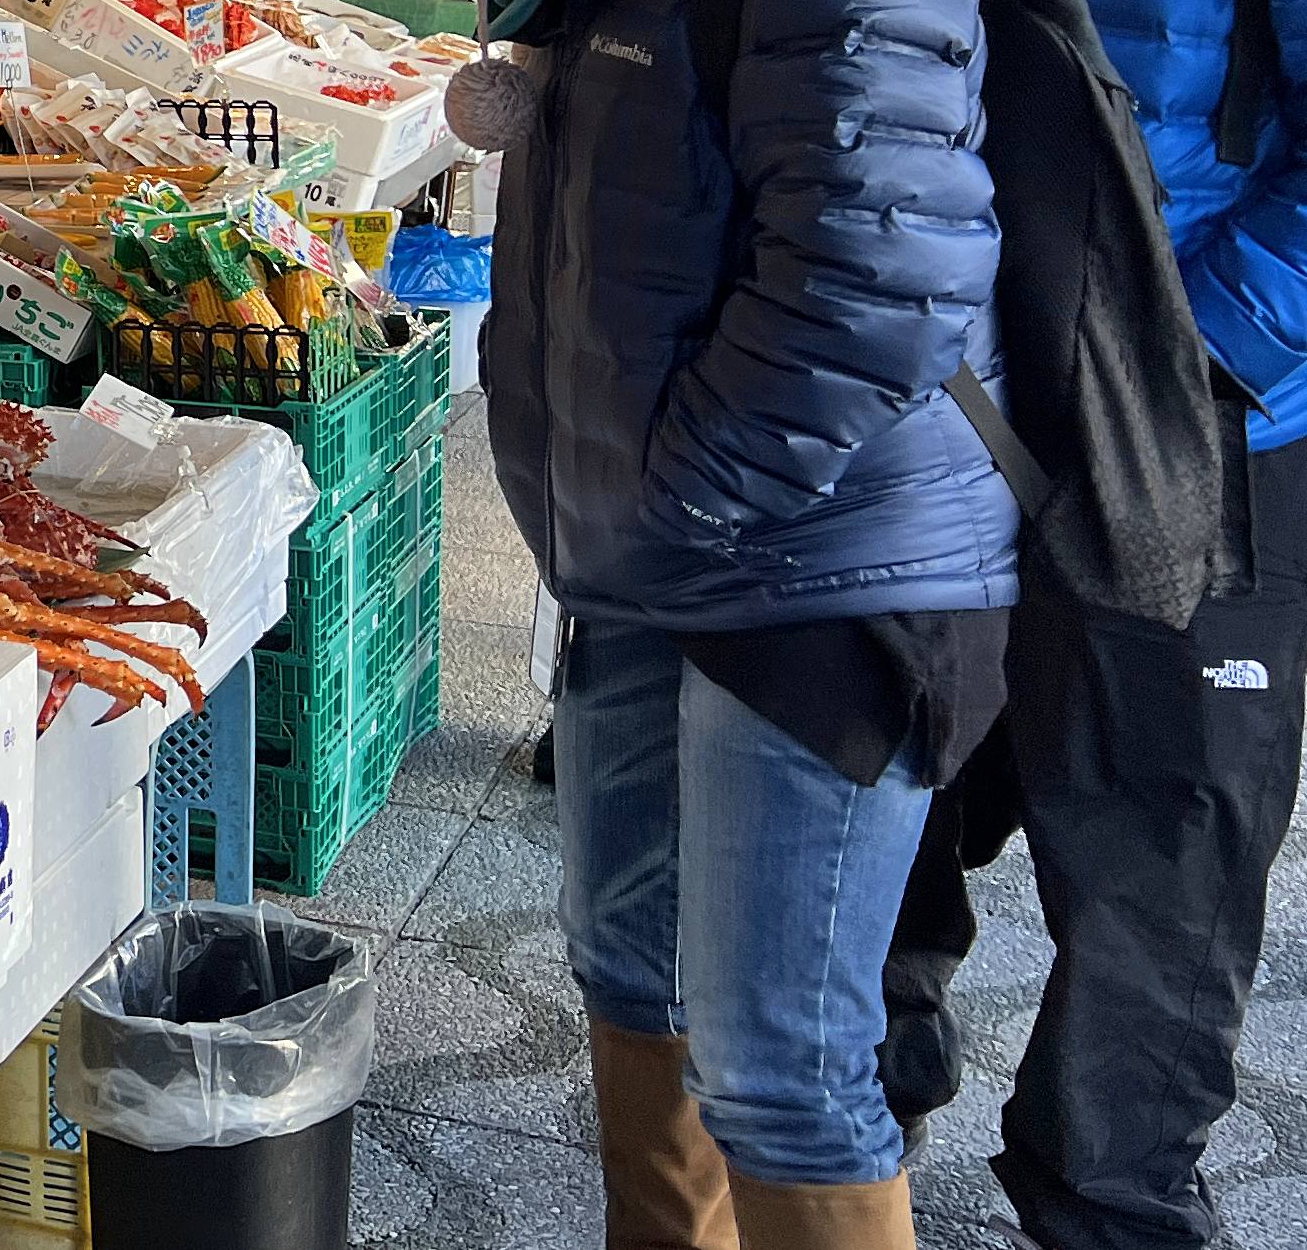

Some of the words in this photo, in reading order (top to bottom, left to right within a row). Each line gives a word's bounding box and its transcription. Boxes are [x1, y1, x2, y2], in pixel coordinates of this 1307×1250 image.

[597, 34, 653, 67] Columbia
[303, 182, 323, 202] 10
[1202, 667, 1244, 681] NORTH
